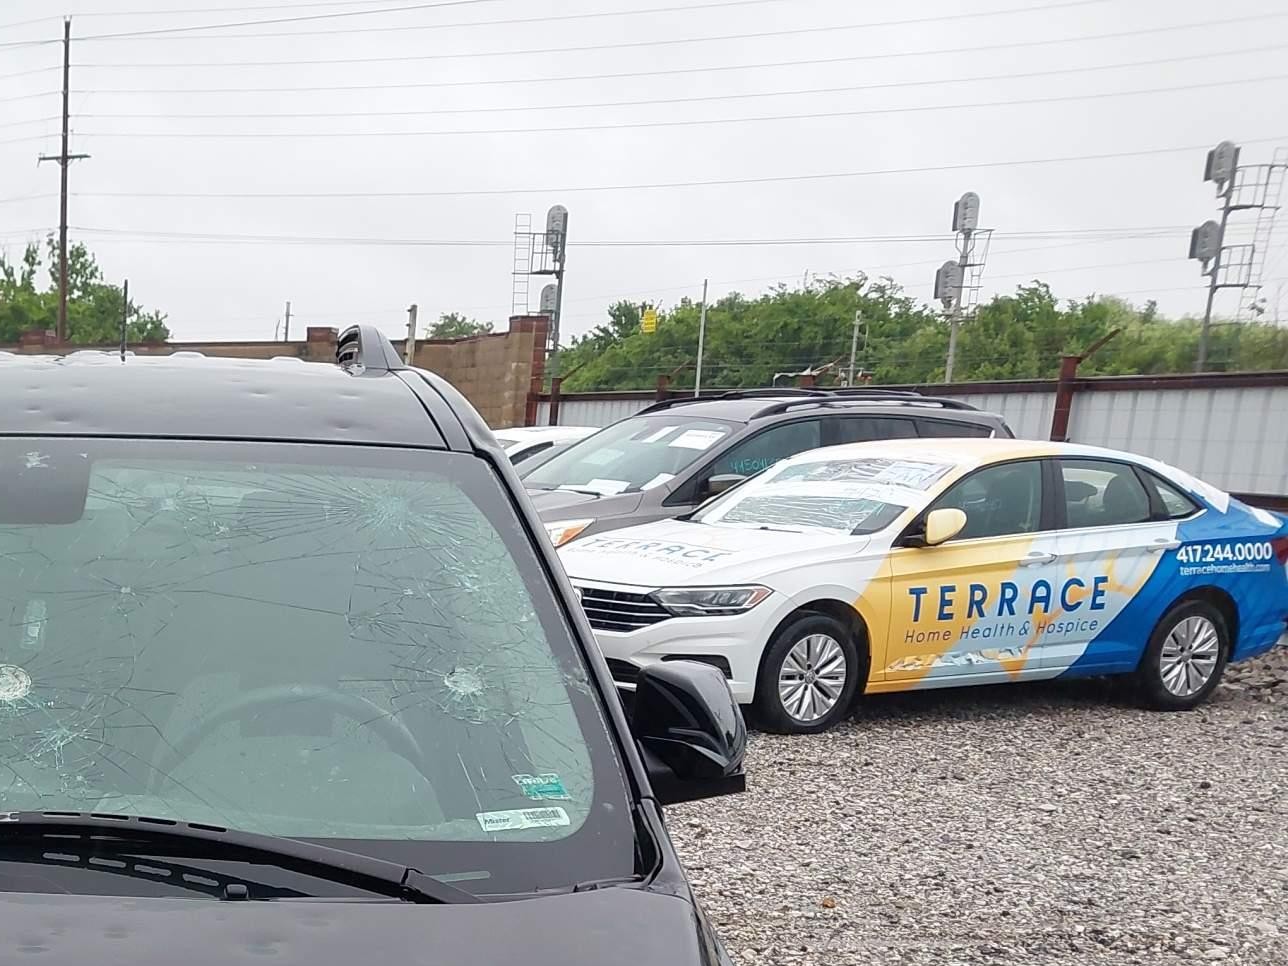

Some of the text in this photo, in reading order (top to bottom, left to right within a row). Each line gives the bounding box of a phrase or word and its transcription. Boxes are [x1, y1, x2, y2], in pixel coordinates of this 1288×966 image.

[1176, 543, 1273, 563] 417.244.0000
[908, 576, 1108, 622] TERRACE
[904, 617, 1099, 644] Home Health & Hospice
